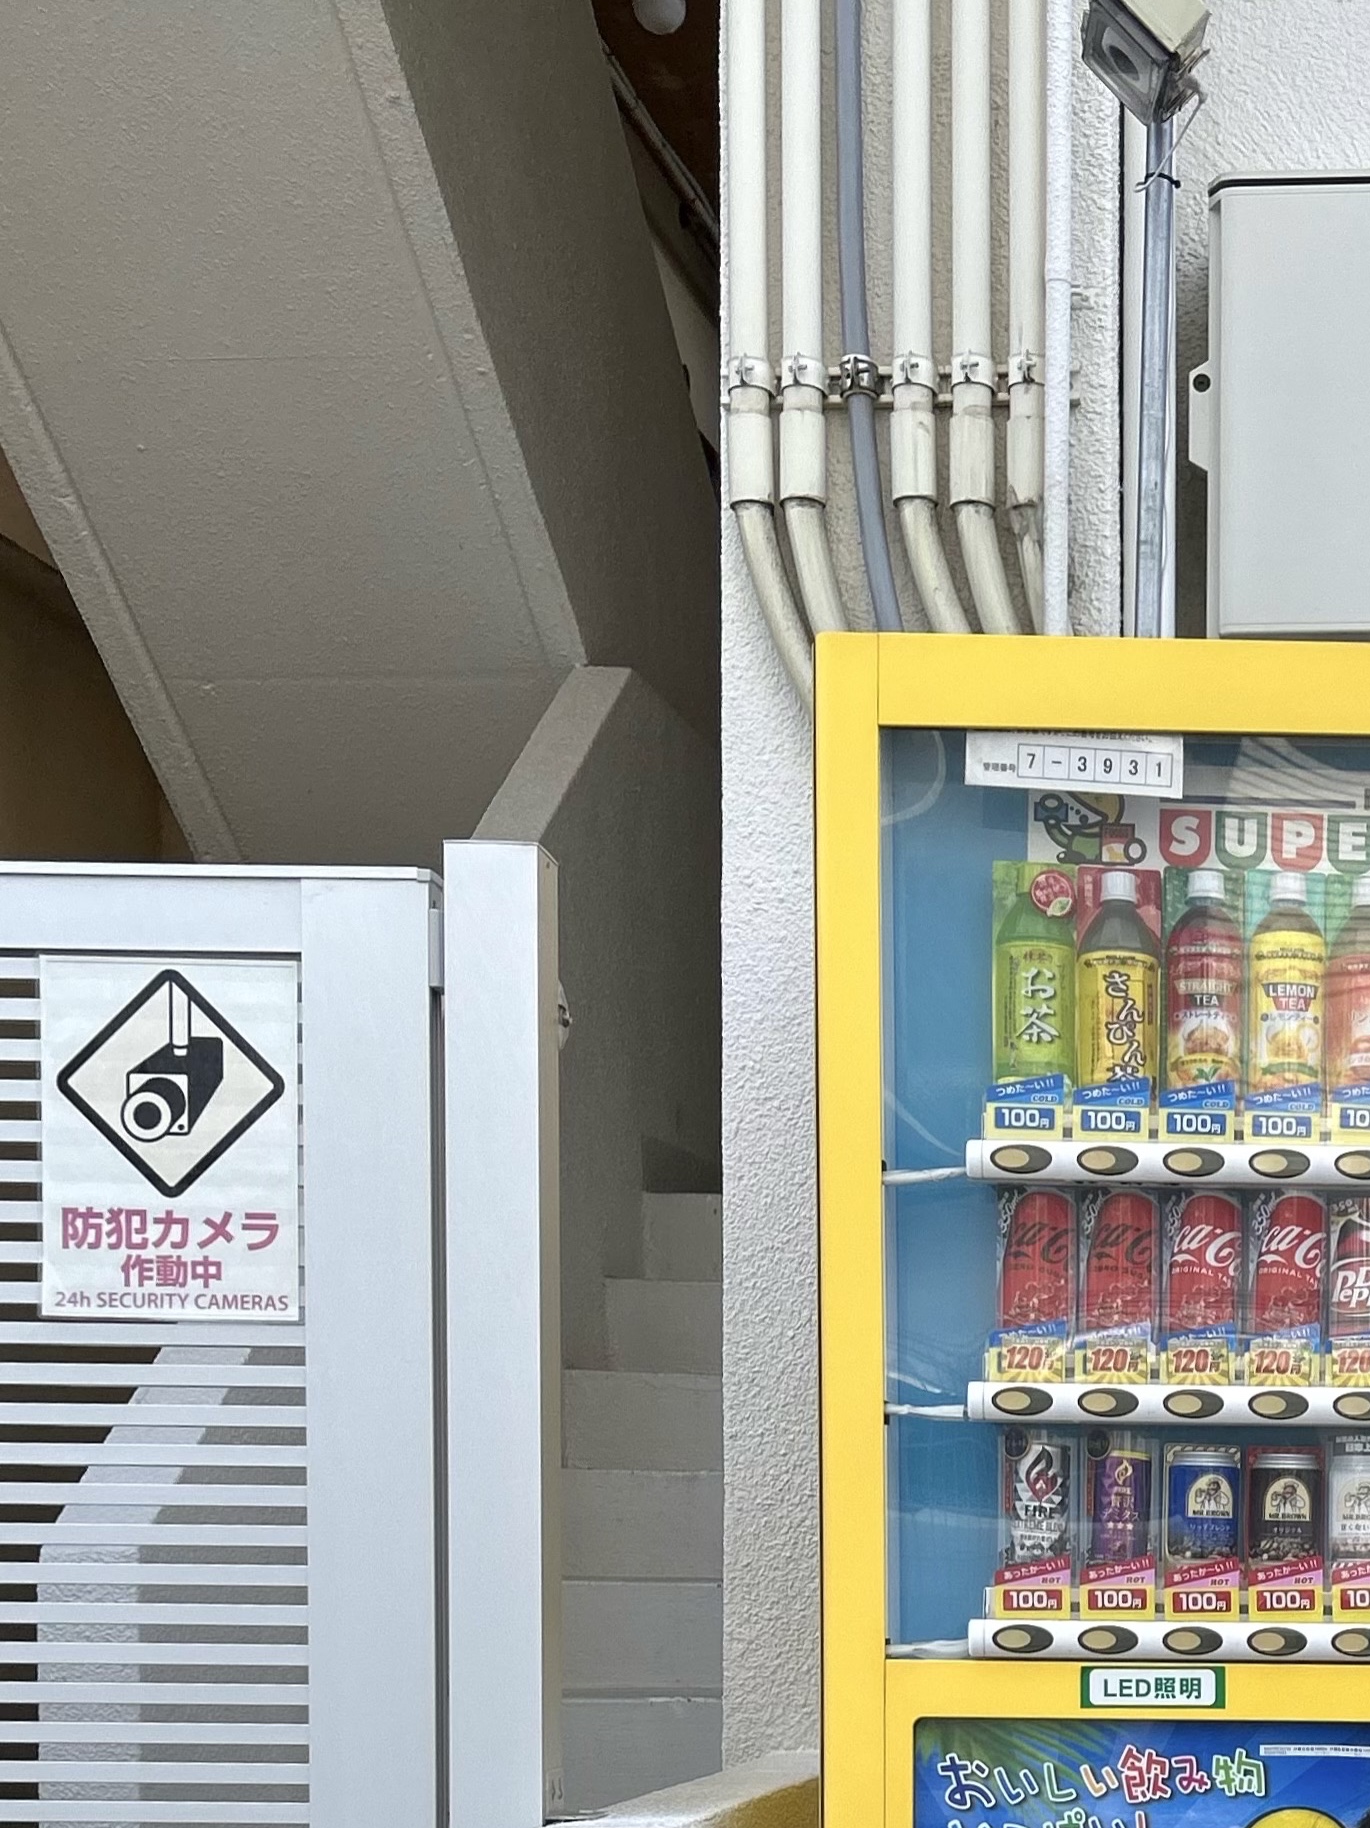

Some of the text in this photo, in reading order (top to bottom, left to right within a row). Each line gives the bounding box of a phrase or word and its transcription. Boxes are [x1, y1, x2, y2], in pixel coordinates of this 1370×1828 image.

[1194, 995, 1220, 1007] TEA
[1269, 986, 1315, 997] LEMON
[1016, 967, 1061, 1044] お茶
[1279, 998, 1306, 1010] TEA
[1001, 1108, 1049, 1128] 100円
[1087, 1111, 1136, 1131] 100円
[1173, 1114, 1221, 1134] 100円
[1259, 1116, 1307, 1137] 100円
[60, 1207, 281, 1253] 防犯カメラ
[120, 1254, 224, 1289] 作動中
[54, 1291, 289, 1313] 24h SECURITY CAMERAS
[1024, 1504, 1055, 1519] FIRE
[1126, 1576, 1145, 1584] HOT
[1210, 1578, 1230, 1586] HOT
[1009, 1591, 1057, 1609] 100円
[1094, 1591, 1142, 1609] 100円
[1179, 1593, 1226, 1611] 100円
[1263, 1592, 1310, 1609] 100円
[1103, 1676, 1203, 1700] LED照明
[937, 1745, 1267, 1812] おいしい飲み物
